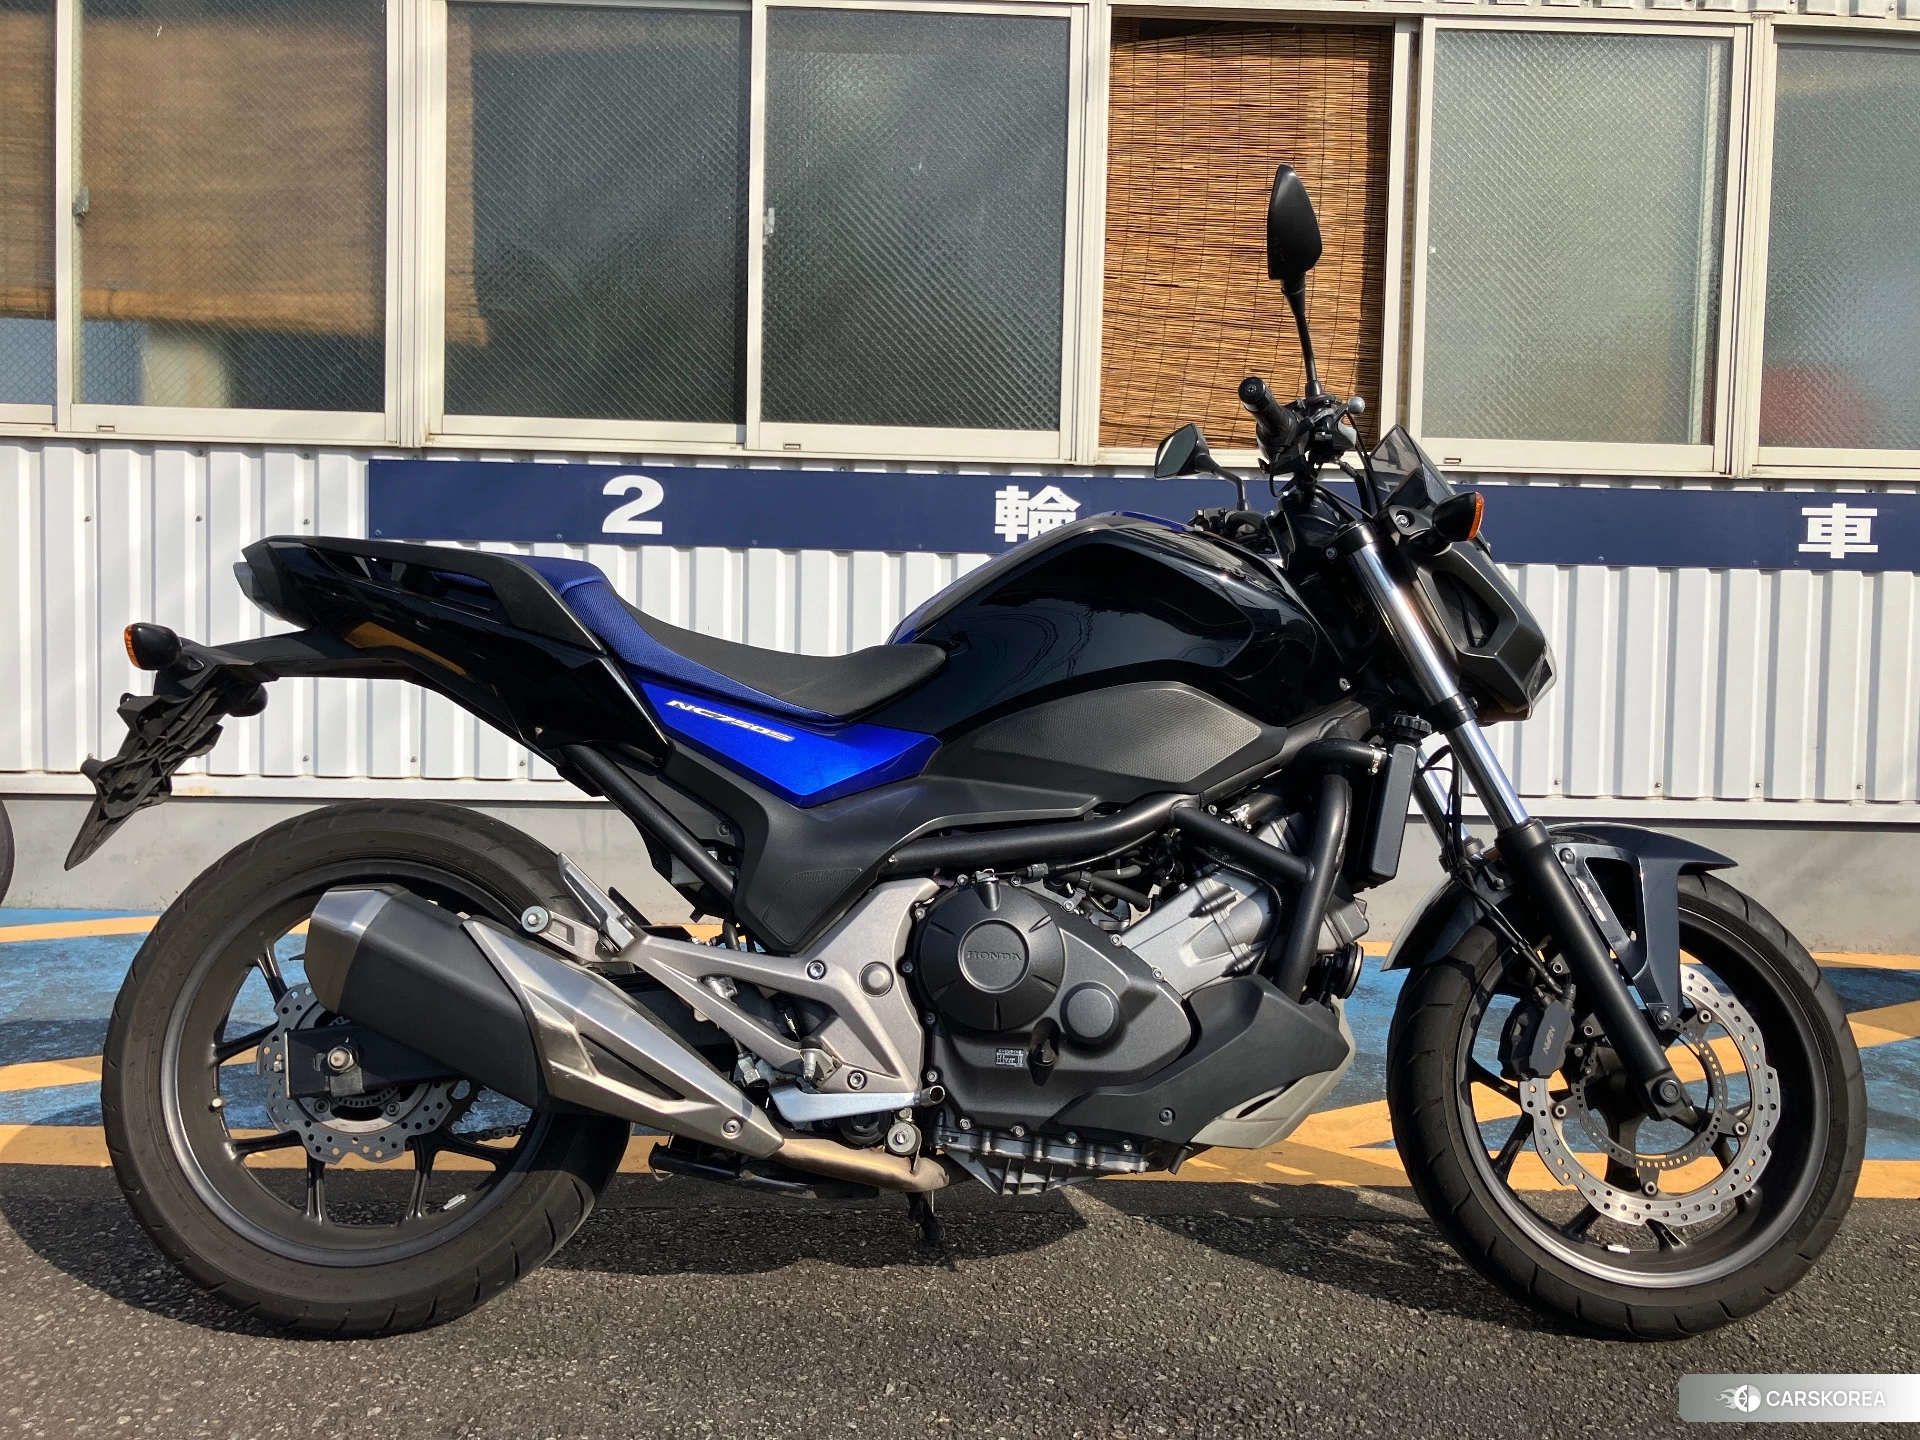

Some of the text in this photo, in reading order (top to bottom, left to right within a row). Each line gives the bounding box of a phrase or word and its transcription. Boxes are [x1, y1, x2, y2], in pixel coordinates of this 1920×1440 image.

[602, 475, 1878, 559] 2 輪 車
[666, 700, 795, 742] NC750S
[966, 950, 1022, 961] HONDA
